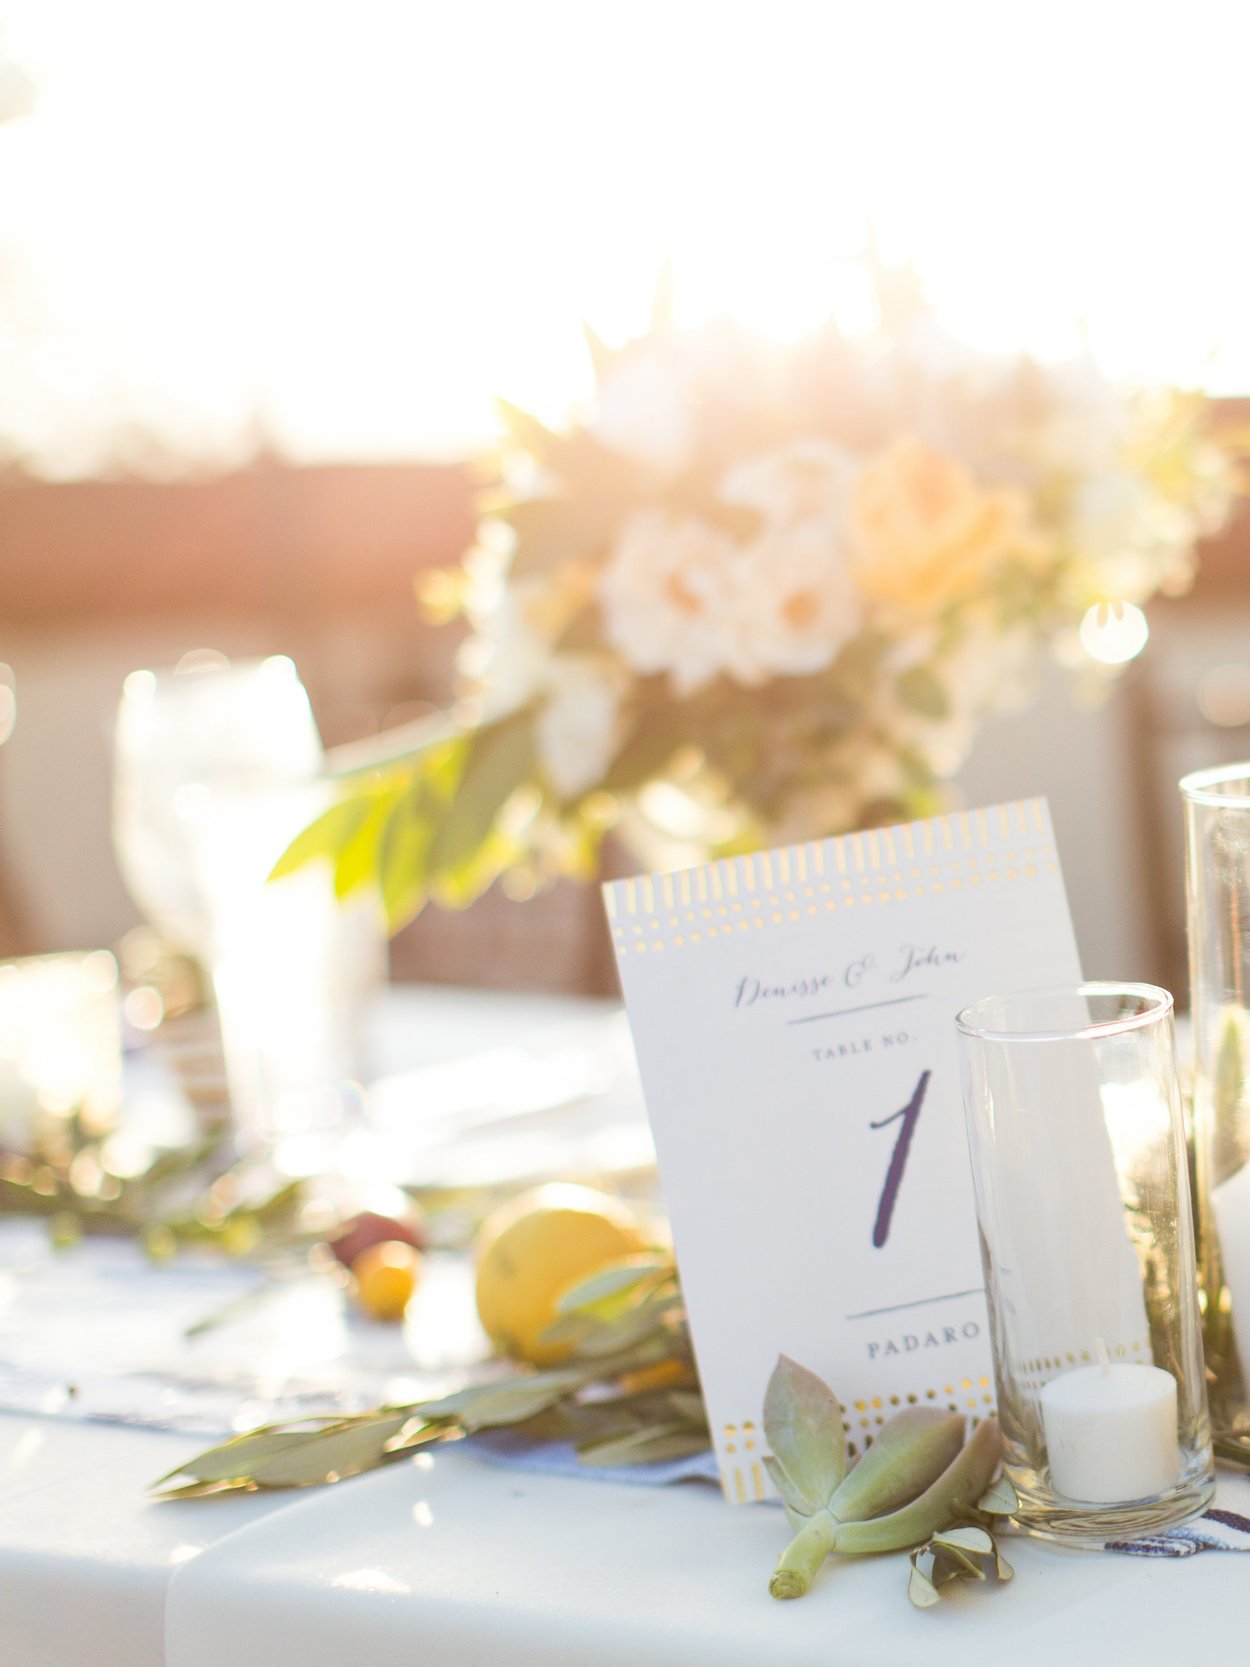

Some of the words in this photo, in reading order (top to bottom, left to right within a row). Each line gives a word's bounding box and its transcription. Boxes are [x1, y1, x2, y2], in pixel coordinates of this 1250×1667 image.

[843, 953, 877, 988] &
[889, 944, 967, 982] John
[812, 1037, 873, 1062] TABLE
[883, 1031, 917, 1050] NO.
[869, 1069, 932, 1249] 1
[867, 1321, 981, 1360] PADARO
